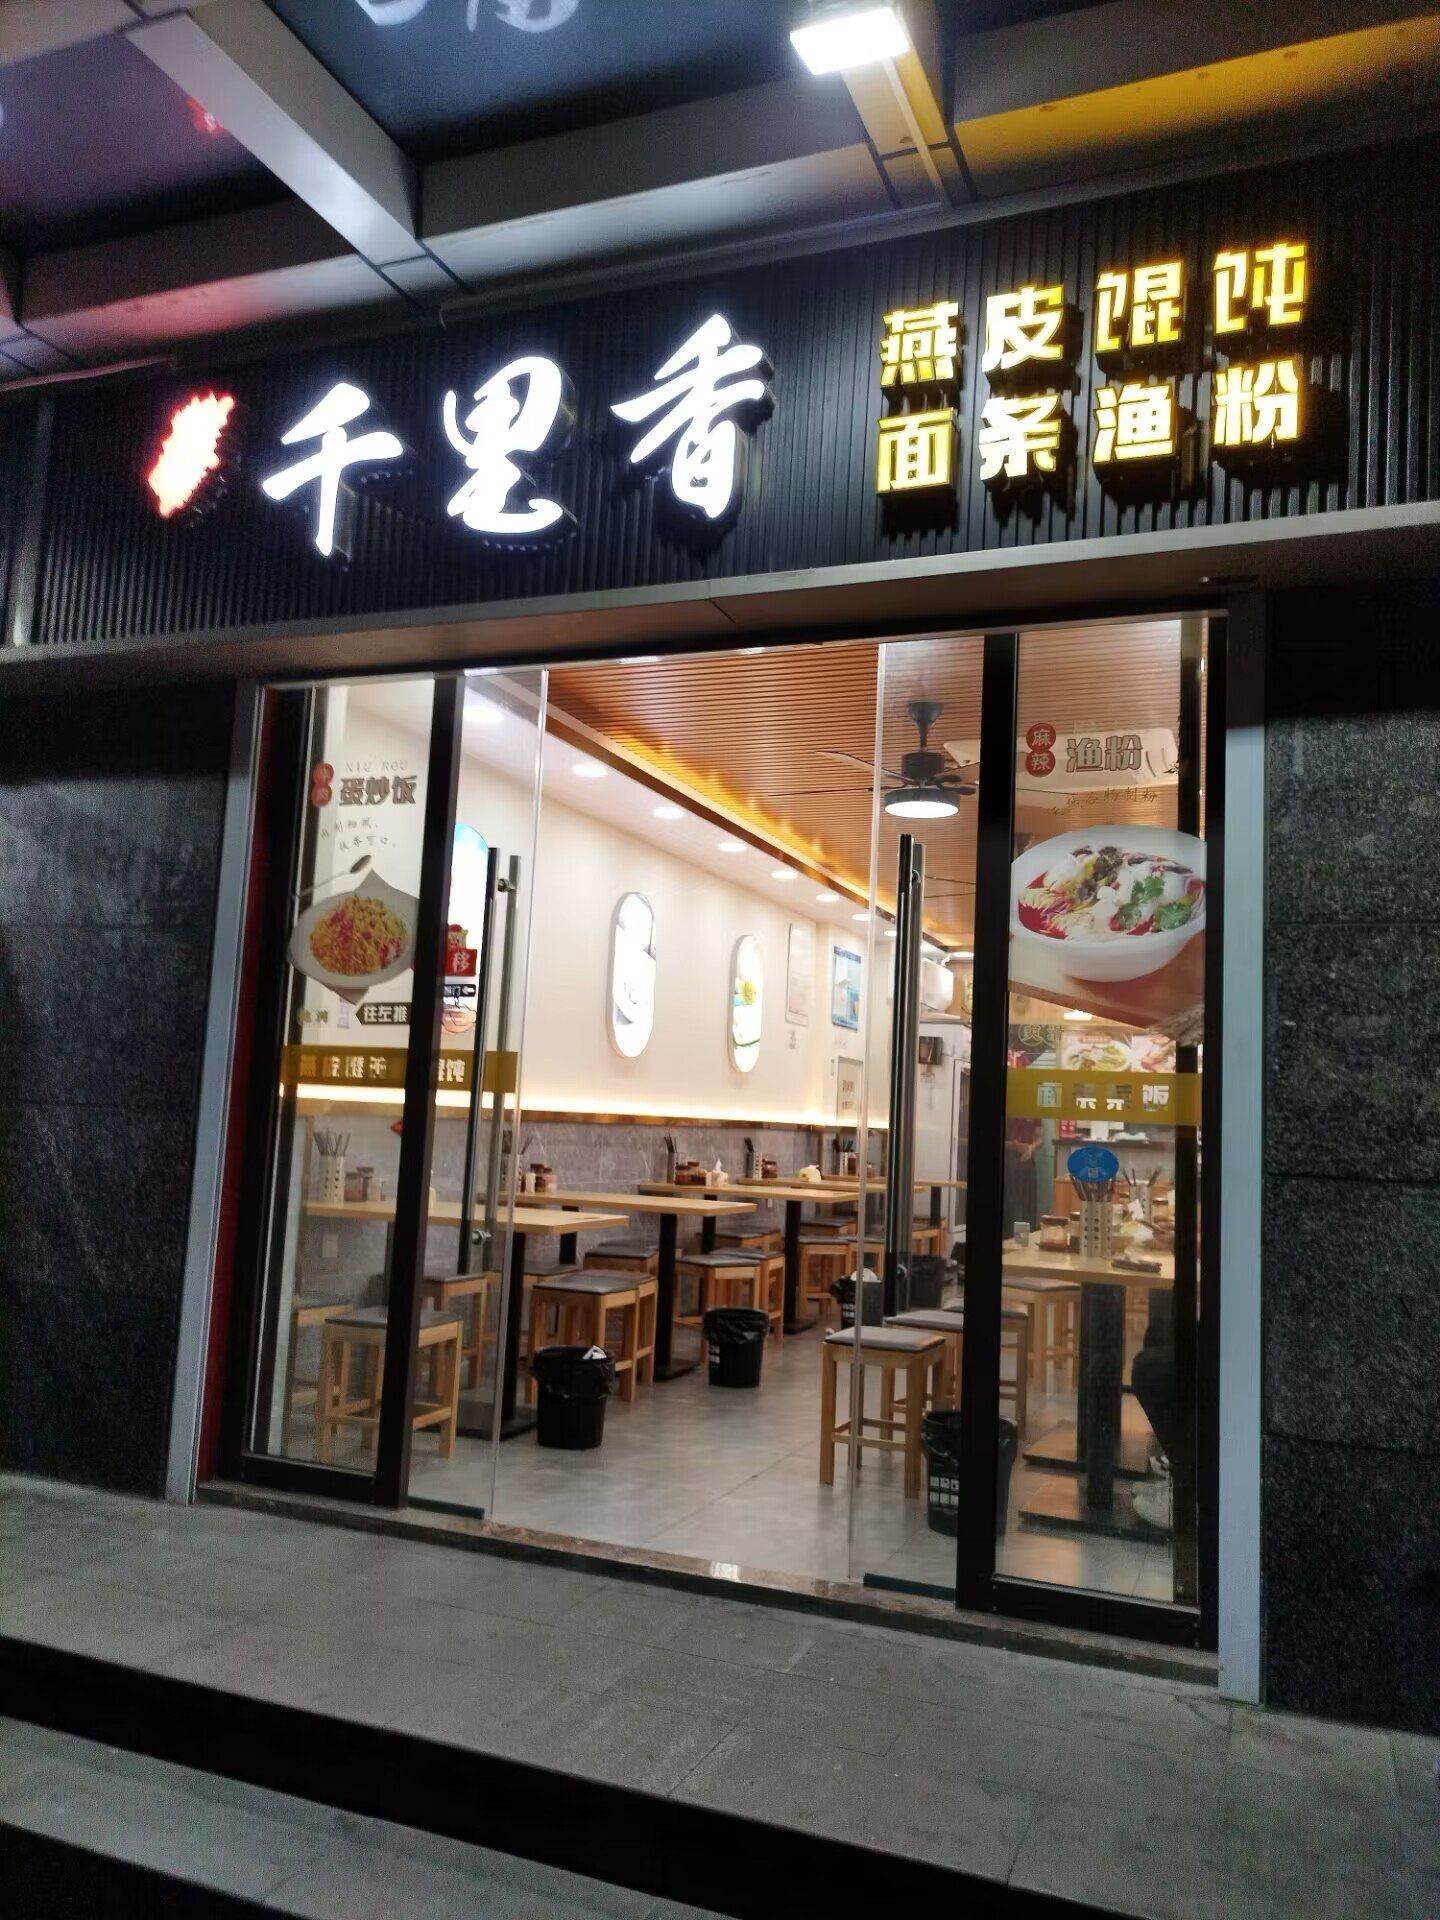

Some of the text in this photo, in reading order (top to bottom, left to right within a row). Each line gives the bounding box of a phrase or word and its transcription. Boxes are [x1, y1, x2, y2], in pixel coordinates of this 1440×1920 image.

[880, 243, 1307, 387] 燕皮馄饨
[262, 314, 766, 557] 千里香
[877, 360, 1300, 493] 面条渔粉
[1030, 727, 1052, 772] 麻辣
[1066, 735, 1143, 773] 渔粉
[339, 775, 417, 806] 蛋炒饭
[363, 1004, 409, 1023] 往左推
